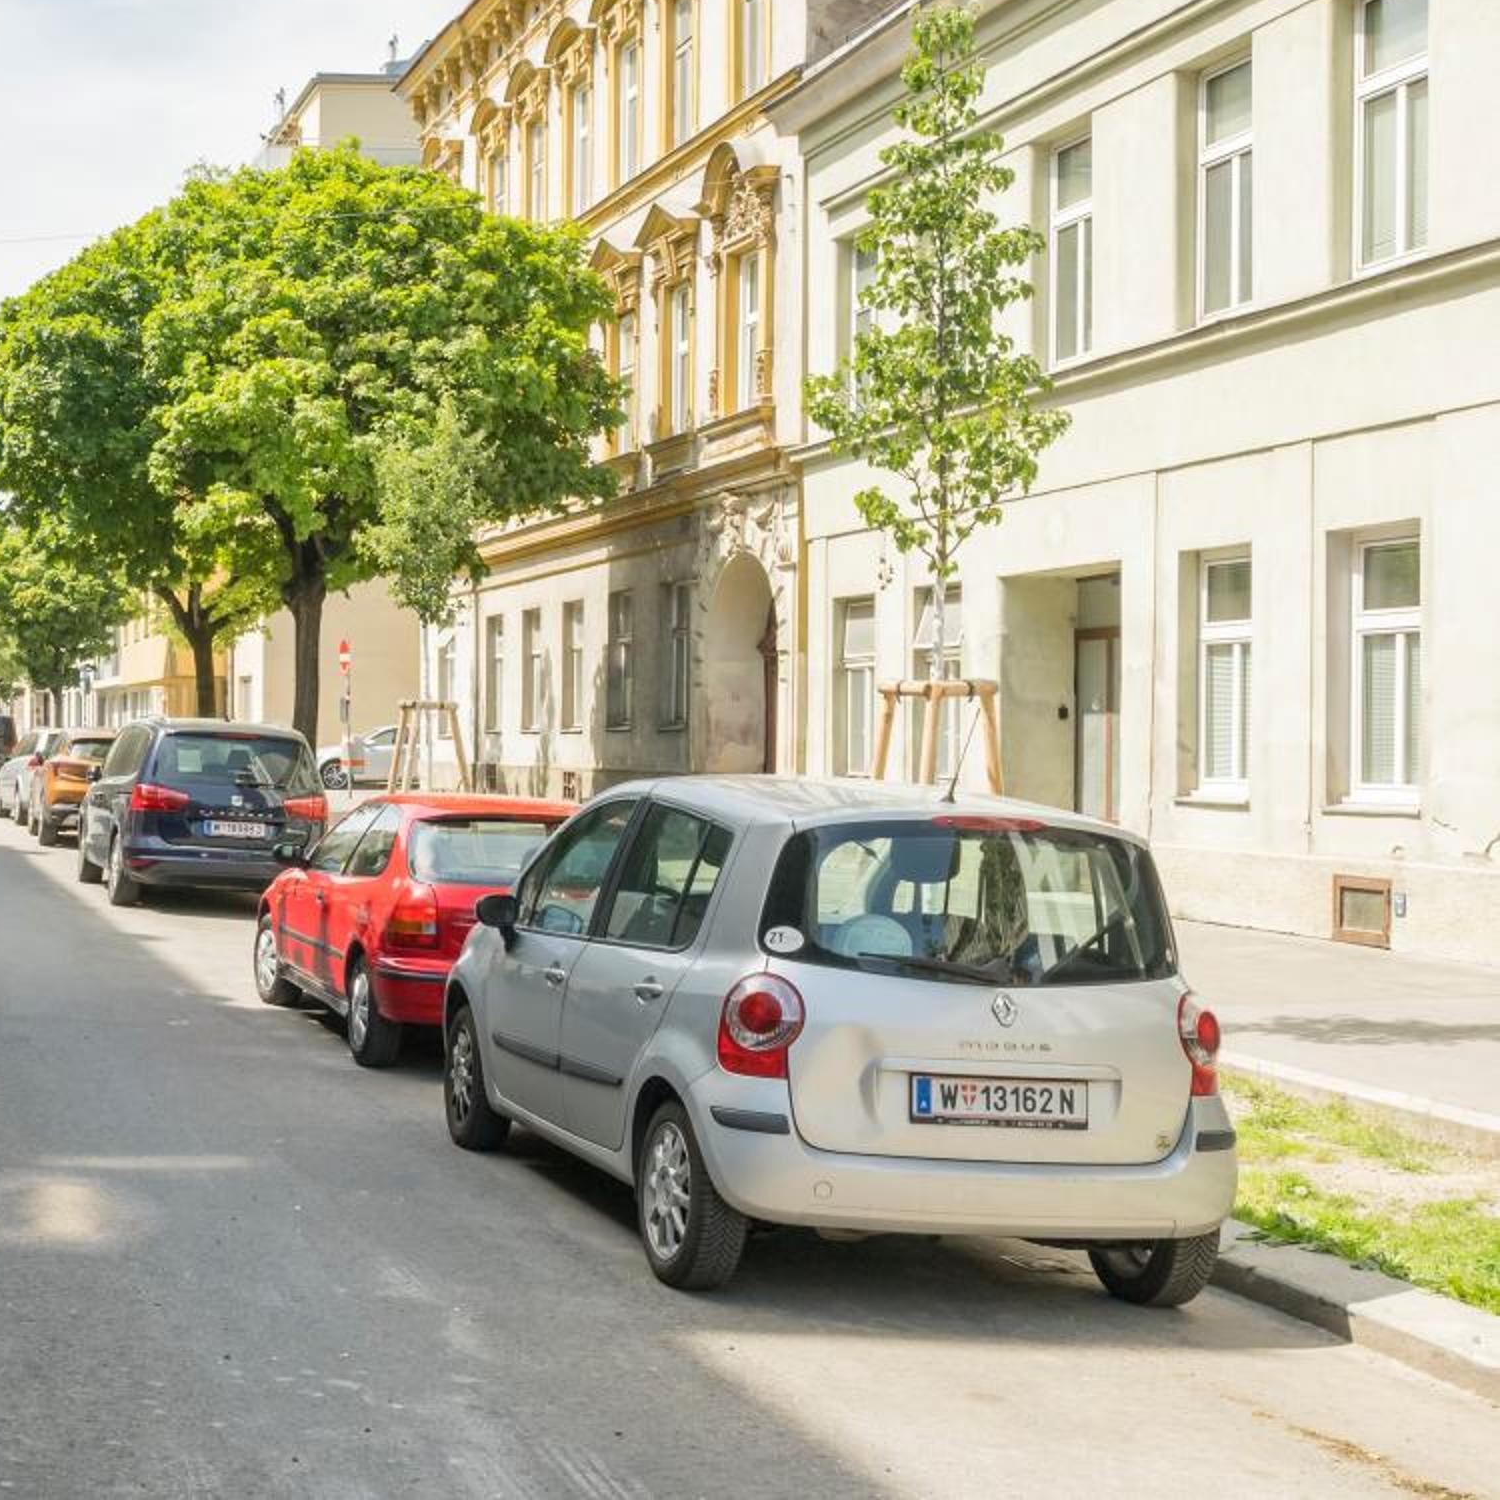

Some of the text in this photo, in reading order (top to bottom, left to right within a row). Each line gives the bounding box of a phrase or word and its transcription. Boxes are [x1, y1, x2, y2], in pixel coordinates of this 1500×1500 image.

[940, 1083, 1075, 1115] W 13162 N
